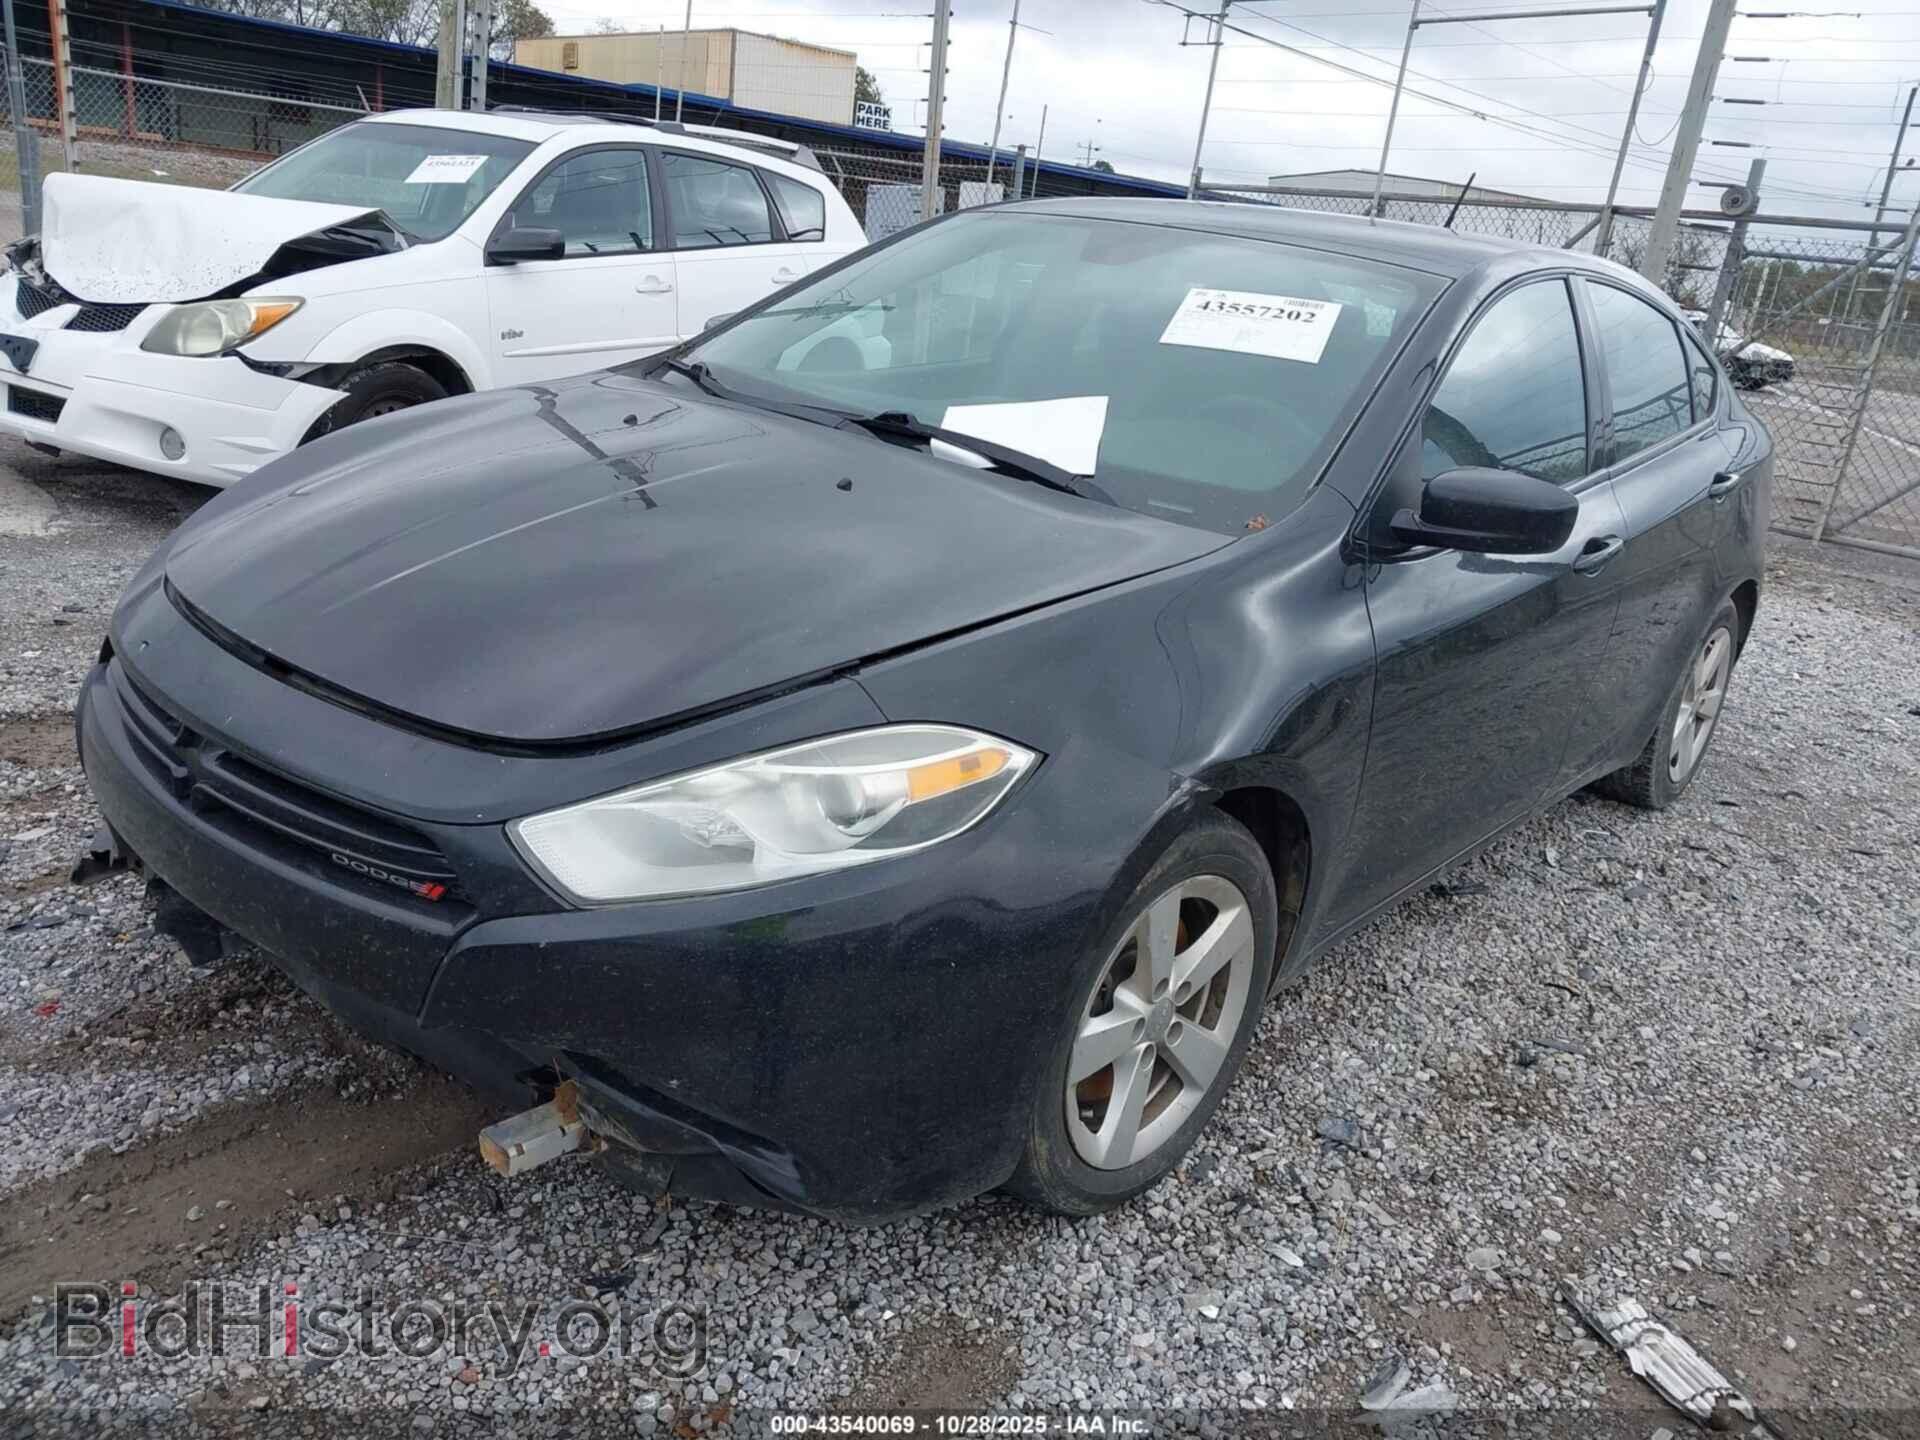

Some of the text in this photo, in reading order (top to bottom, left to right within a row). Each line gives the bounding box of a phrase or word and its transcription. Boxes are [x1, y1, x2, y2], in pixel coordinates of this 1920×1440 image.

[858, 103, 891, 118] PARK
[856, 115, 890, 130] HERE
[1196, 300, 1317, 323] 43557202
[331, 853, 430, 894] DODGE
